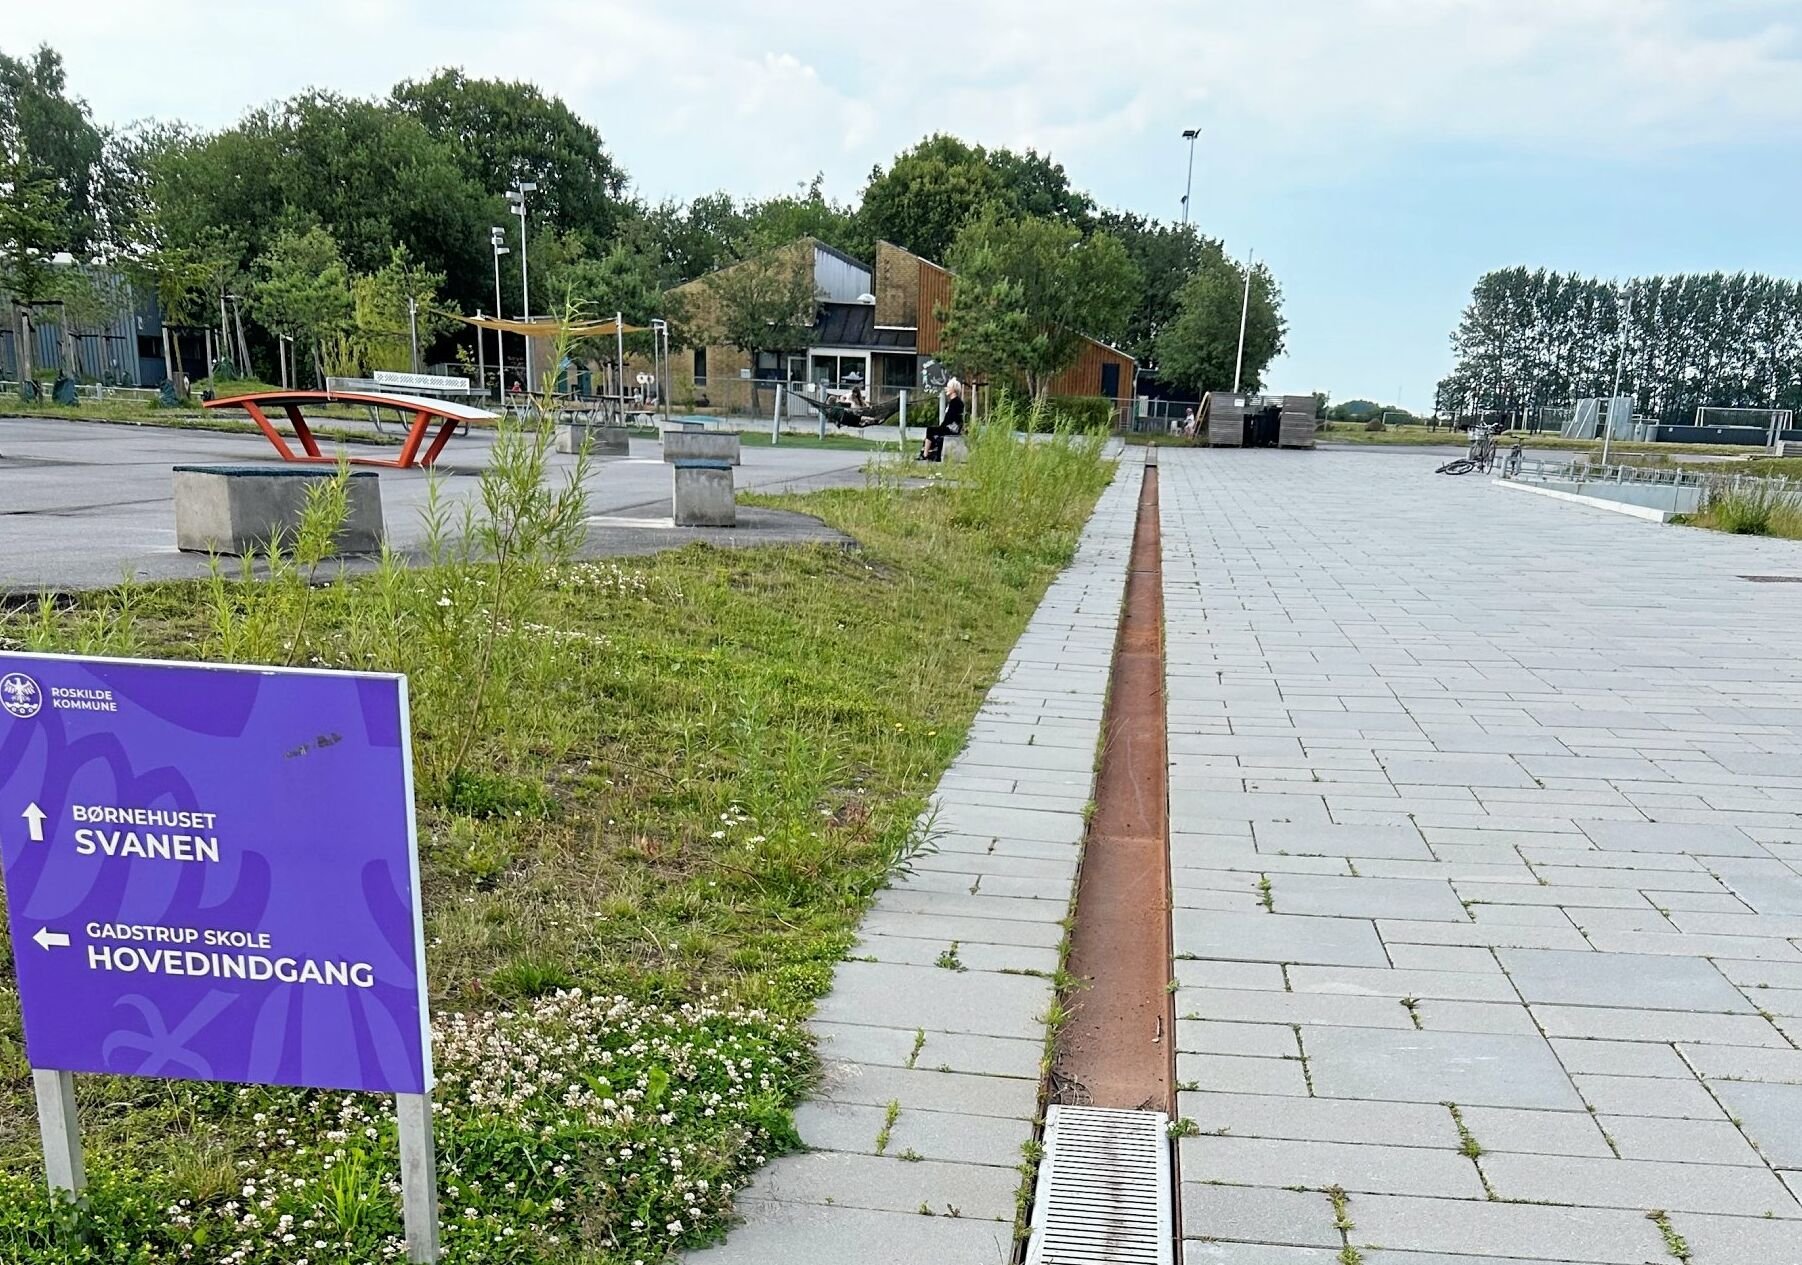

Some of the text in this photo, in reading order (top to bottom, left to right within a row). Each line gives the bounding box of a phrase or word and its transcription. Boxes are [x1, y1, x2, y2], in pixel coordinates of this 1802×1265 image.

[51, 687, 113, 700] ROSKILDE
[53, 699, 118, 712] KOMMUNE
[72, 804, 217, 830] BØRNEHUSET
[75, 829, 220, 863] SVANEN
[86, 922, 271, 949] GADSTRUP SKOLE
[87, 944, 375, 988] HOVEDINDGANG
